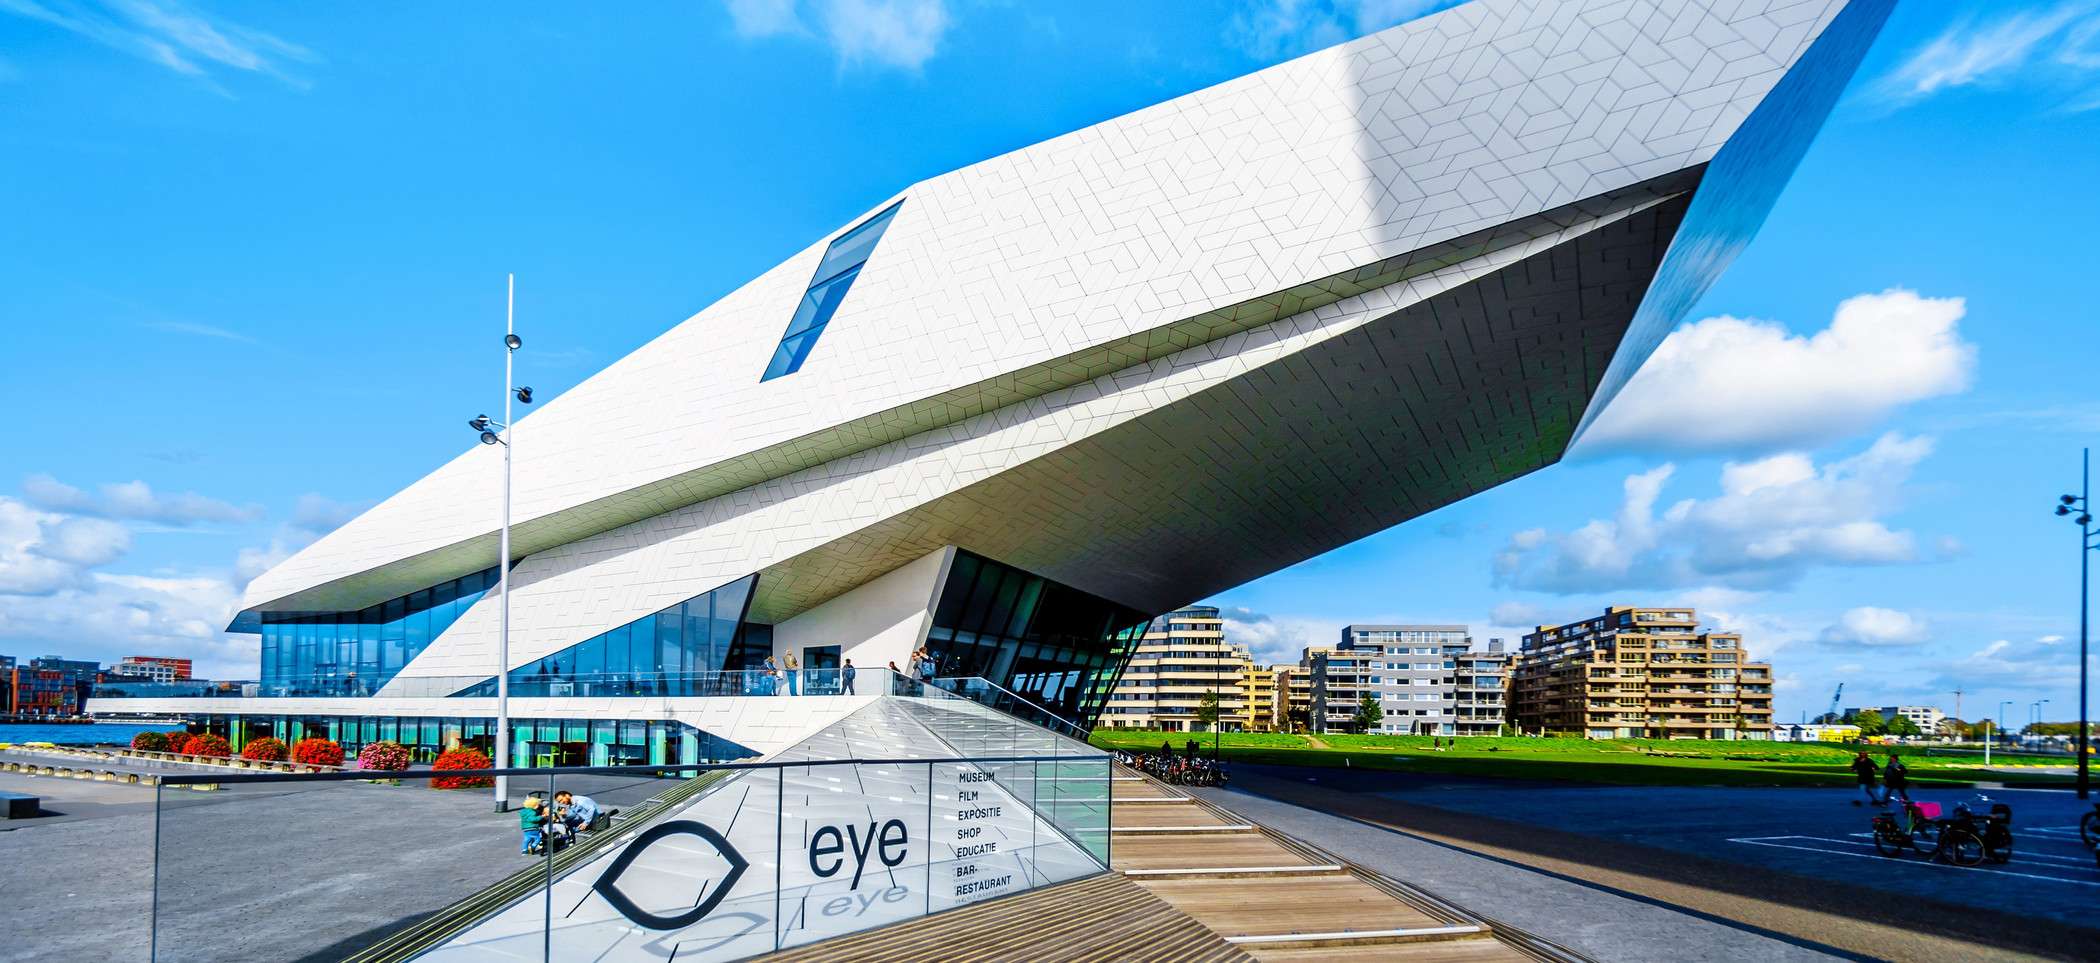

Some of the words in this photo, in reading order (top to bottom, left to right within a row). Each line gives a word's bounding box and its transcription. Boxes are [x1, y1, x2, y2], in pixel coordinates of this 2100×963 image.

[959, 771, 995, 783] MUSEUM
[958, 790, 979, 802] FILM
[958, 806, 1001, 821] EXPOSITIE
[957, 827, 981, 840] SHOP
[809, 818, 908, 891] eye
[957, 842, 996, 858] EDUCATIE
[956, 864, 978, 877] BAR-
[956, 875, 1012, 896] RESTAURANT
